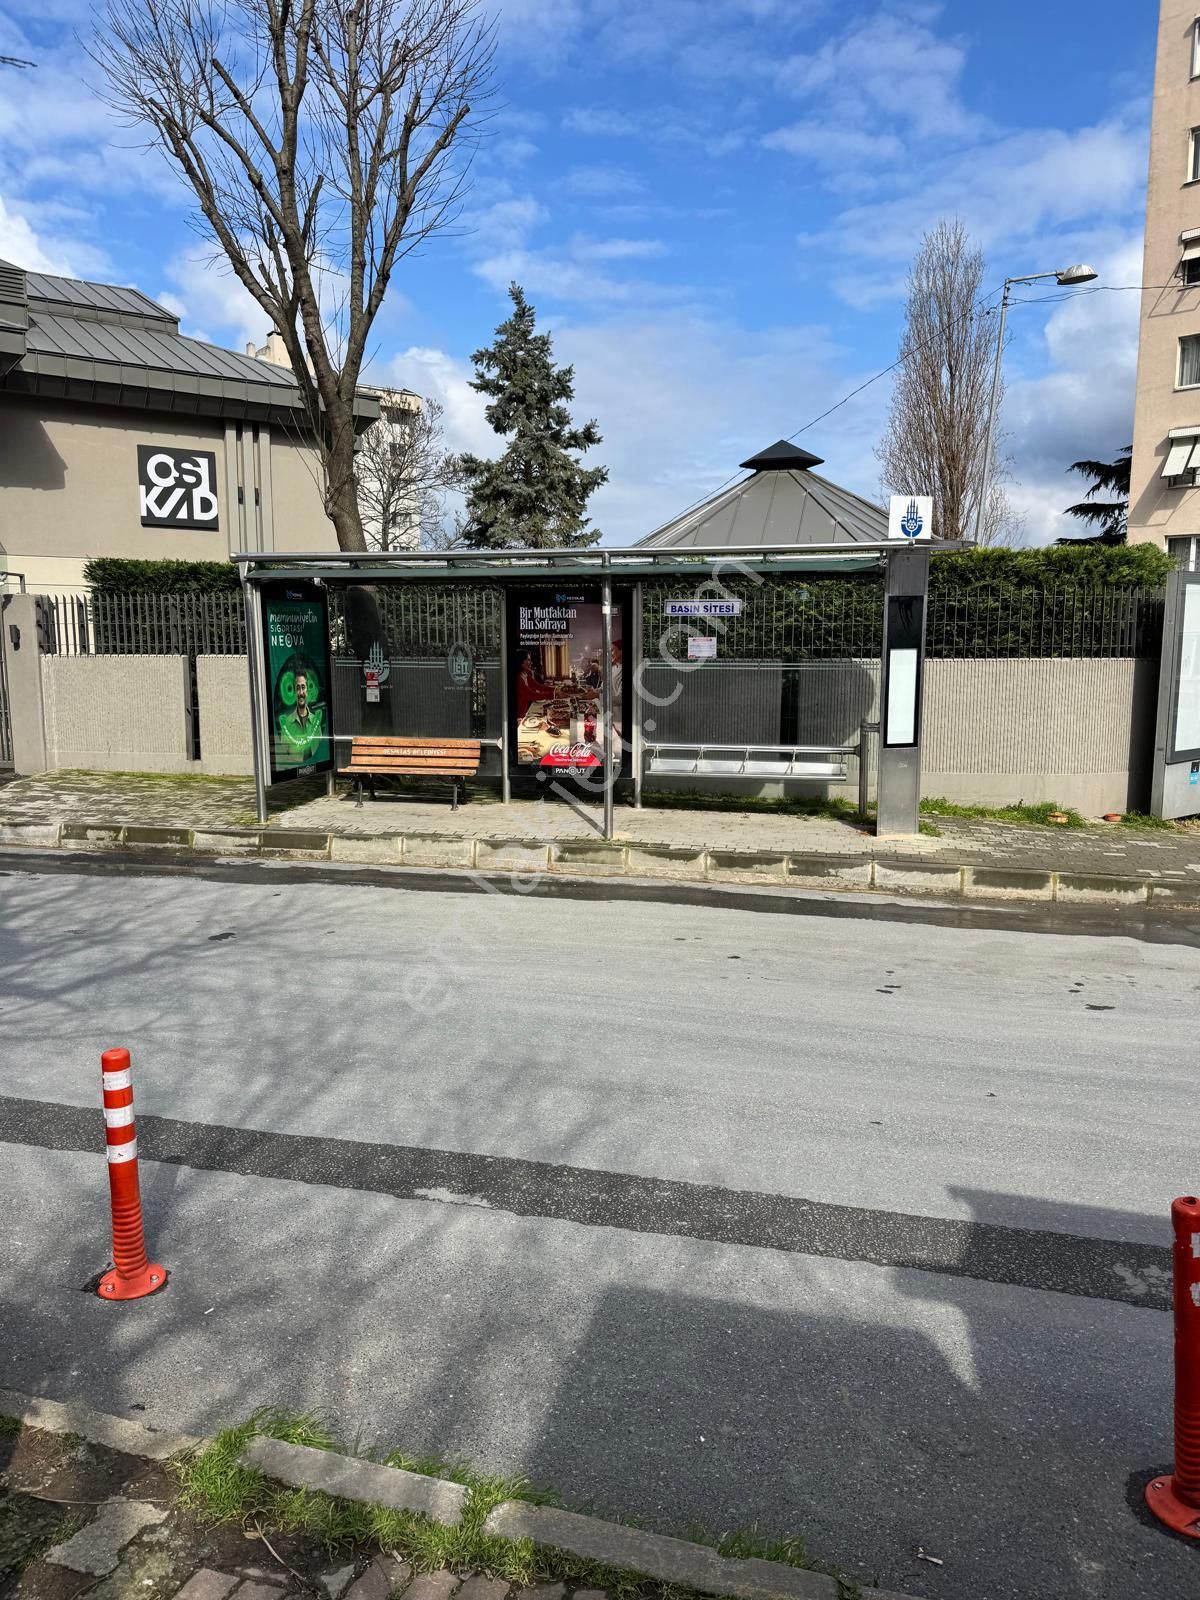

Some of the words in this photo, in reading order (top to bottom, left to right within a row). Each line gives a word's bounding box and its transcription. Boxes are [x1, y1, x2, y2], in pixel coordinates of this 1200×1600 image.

[520, 606, 533, 620] Bir
[533, 606, 577, 619] Mutfaktan
[671, 605, 700, 613] BASIN
[703, 603, 735, 613] SİTESİ
[535, 618, 567, 632] Sofraya
[271, 633, 305, 648] NEOVA
